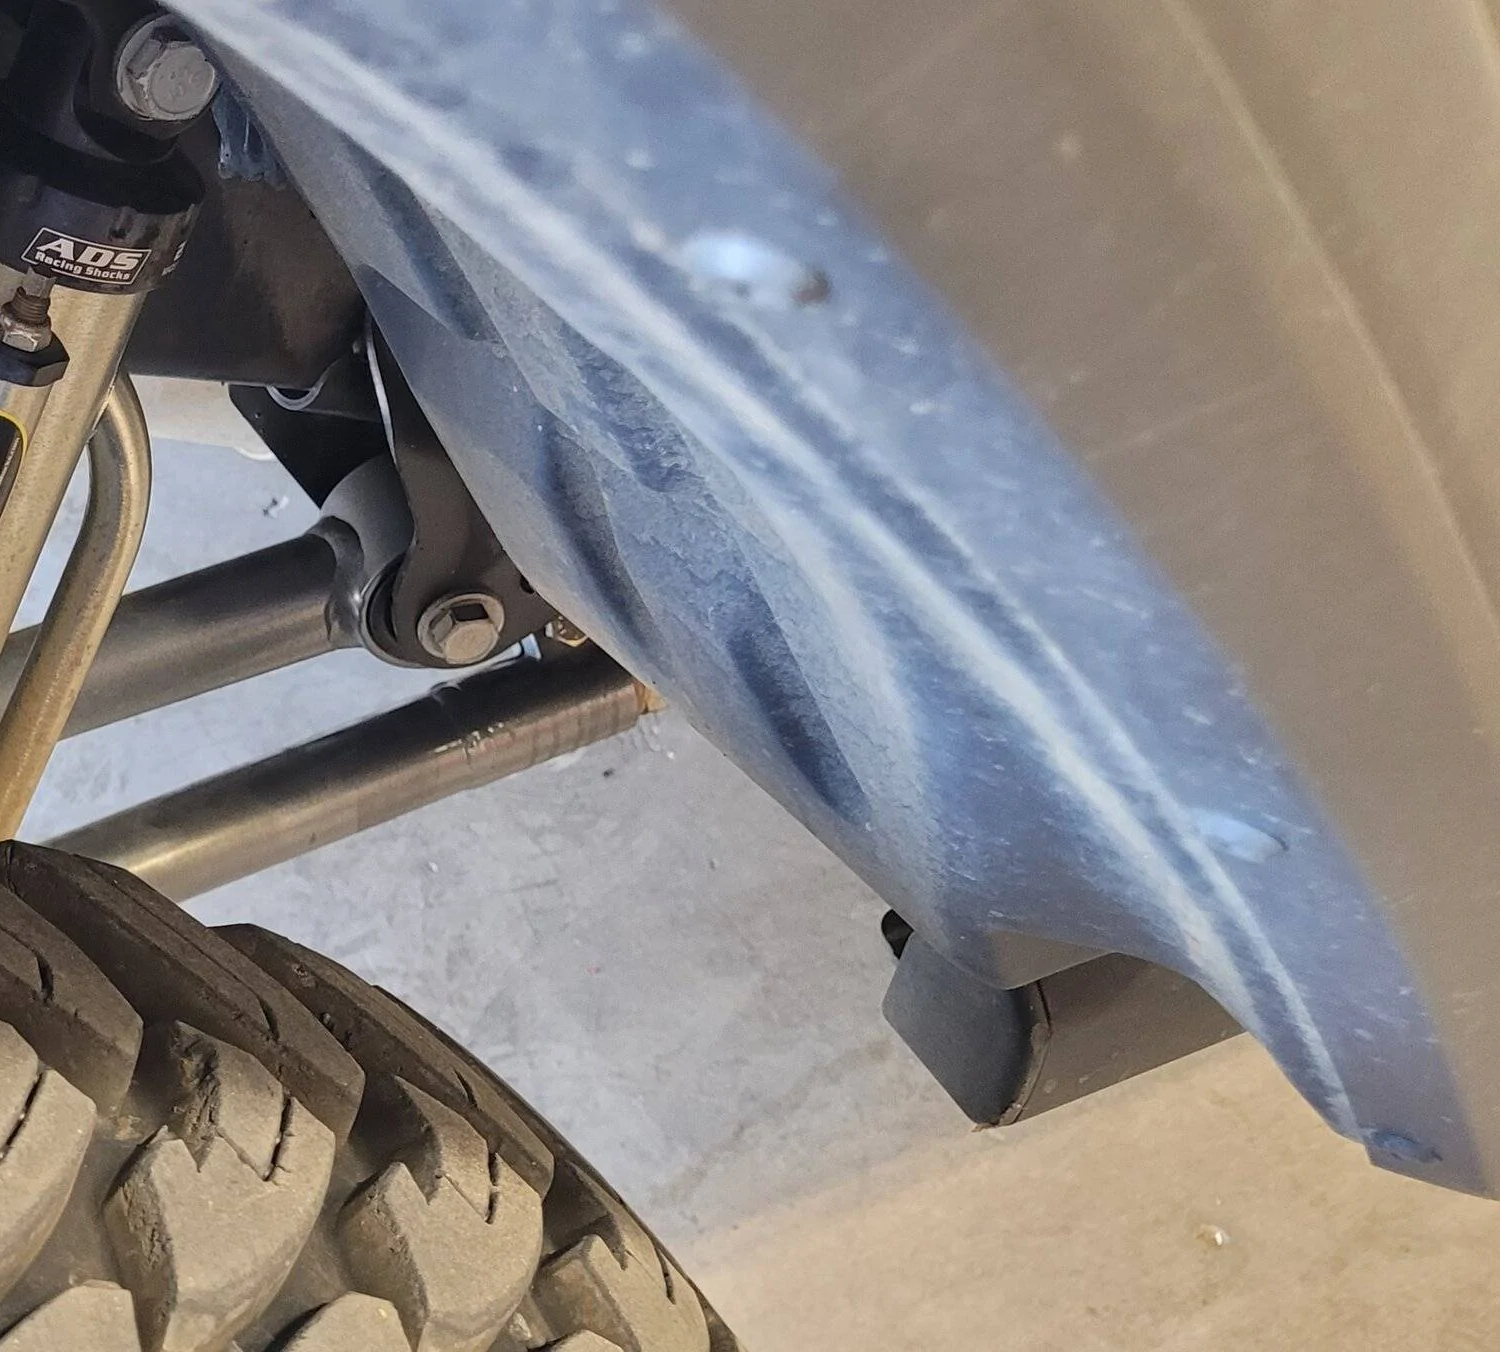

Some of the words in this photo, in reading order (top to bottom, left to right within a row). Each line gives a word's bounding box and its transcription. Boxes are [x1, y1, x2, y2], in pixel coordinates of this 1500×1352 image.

[35, 251, 83, 275] Racing
[85, 266, 131, 280] Shocks
[36, 238, 143, 270] ADS
